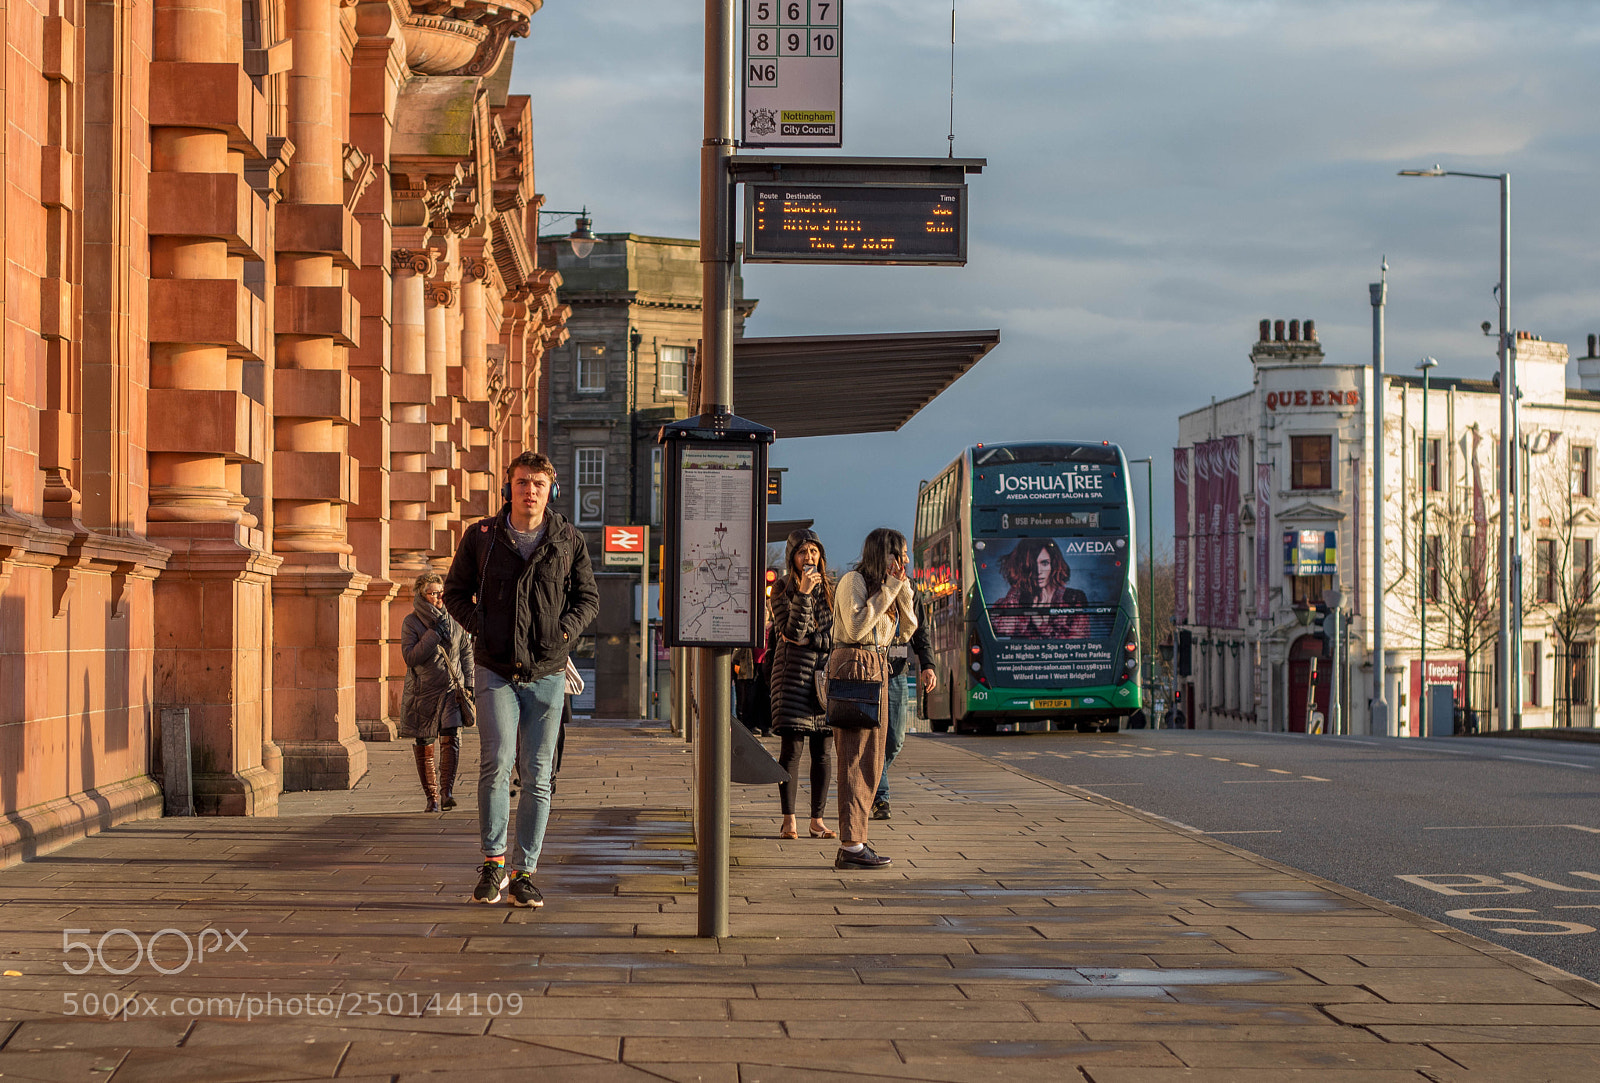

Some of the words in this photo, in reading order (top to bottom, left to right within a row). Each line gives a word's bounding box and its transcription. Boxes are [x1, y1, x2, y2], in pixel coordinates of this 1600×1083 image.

[757, 2, 770, 21] 5
[787, 2, 800, 21] 6
[817, 2, 830, 21] 7
[757, 33, 769, 52] 8
[787, 33, 800, 52] 9
[813, 33, 834, 51] 10
[749, 64, 776, 82] N6
[783, 111, 833, 123] Nottingham
[783, 124, 800, 136] City
[802, 124, 834, 135] Council
[759, 192, 779, 200] Route
[785, 192, 822, 200] Destination
[940, 194, 956, 202] Time
[1266, 389, 1359, 411] QUEENS
[1015, 517, 1028, 526] USB
[1066, 541, 1116, 553] AVEDA
[1211, 542, 1222, 591] Customer
[1176, 578, 1185, 612] Central
[1226, 568, 1236, 615] Fireplace
[1023, 643, 1040, 651] Salon
[1046, 643, 1058, 652] Spa
[1065, 643, 1081, 652] Open
[1087, 642, 1102, 651] Days
[1015, 652, 1035, 661] Nights
[1041, 652, 1053, 661] Spa
[1054, 652, 1068, 660] Days
[1075, 651, 1088, 659] Free
[1089, 651, 1111, 659] Parking
[1069, 672, 1096, 681] Bridgford
[1428, 662, 1459, 679] fireplace
[972, 691, 988, 701] 401
